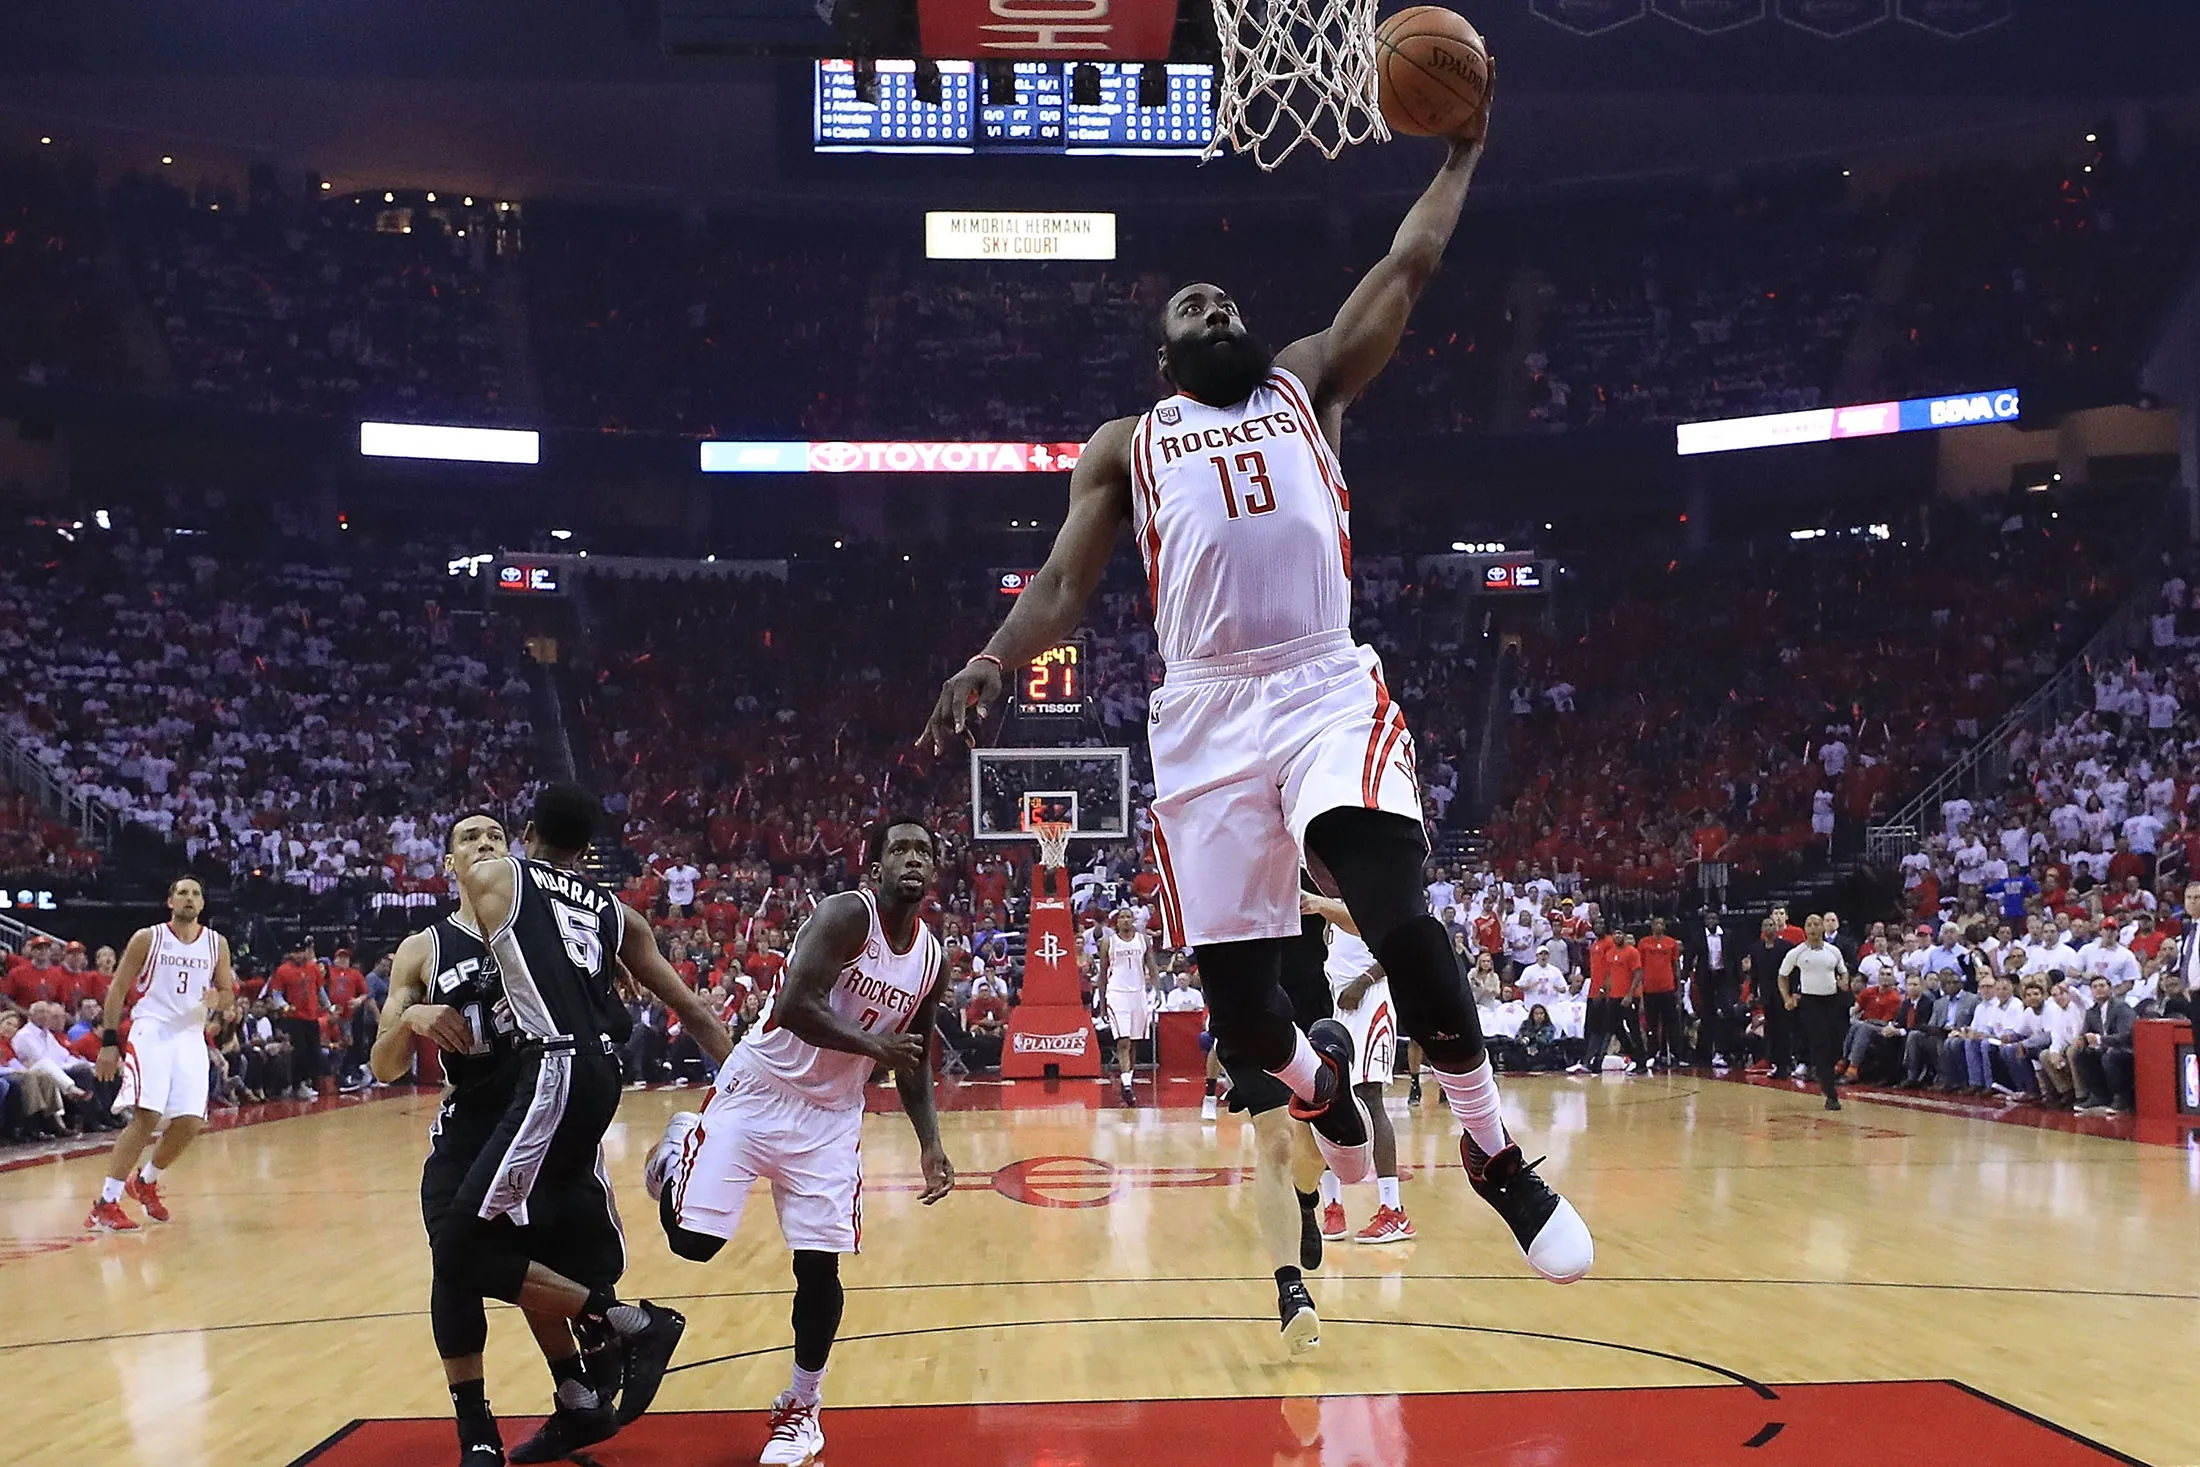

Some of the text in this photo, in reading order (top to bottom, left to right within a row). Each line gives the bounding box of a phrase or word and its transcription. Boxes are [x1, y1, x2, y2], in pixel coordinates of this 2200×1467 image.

[950, 218, 1091, 234] MEMORIAL HERMANN
[982, 236, 1058, 253] SKY COURT
[1157, 411, 1297, 464] ROCKETS
[860, 443, 1023, 470] TOYOTA
[1209, 451, 1278, 519] 13
[1029, 667, 1071, 698] 21
[1037, 703, 1082, 713] TISSOT
[528, 866, 609, 914] MURRAY
[550, 898, 603, 978] 5
[160, 953, 209, 970] ROCKETS
[176, 970, 188, 994] 3
[844, 966, 915, 1013] ROCKETS
[1022, 1036, 1086, 1051] PLAYOFFS
